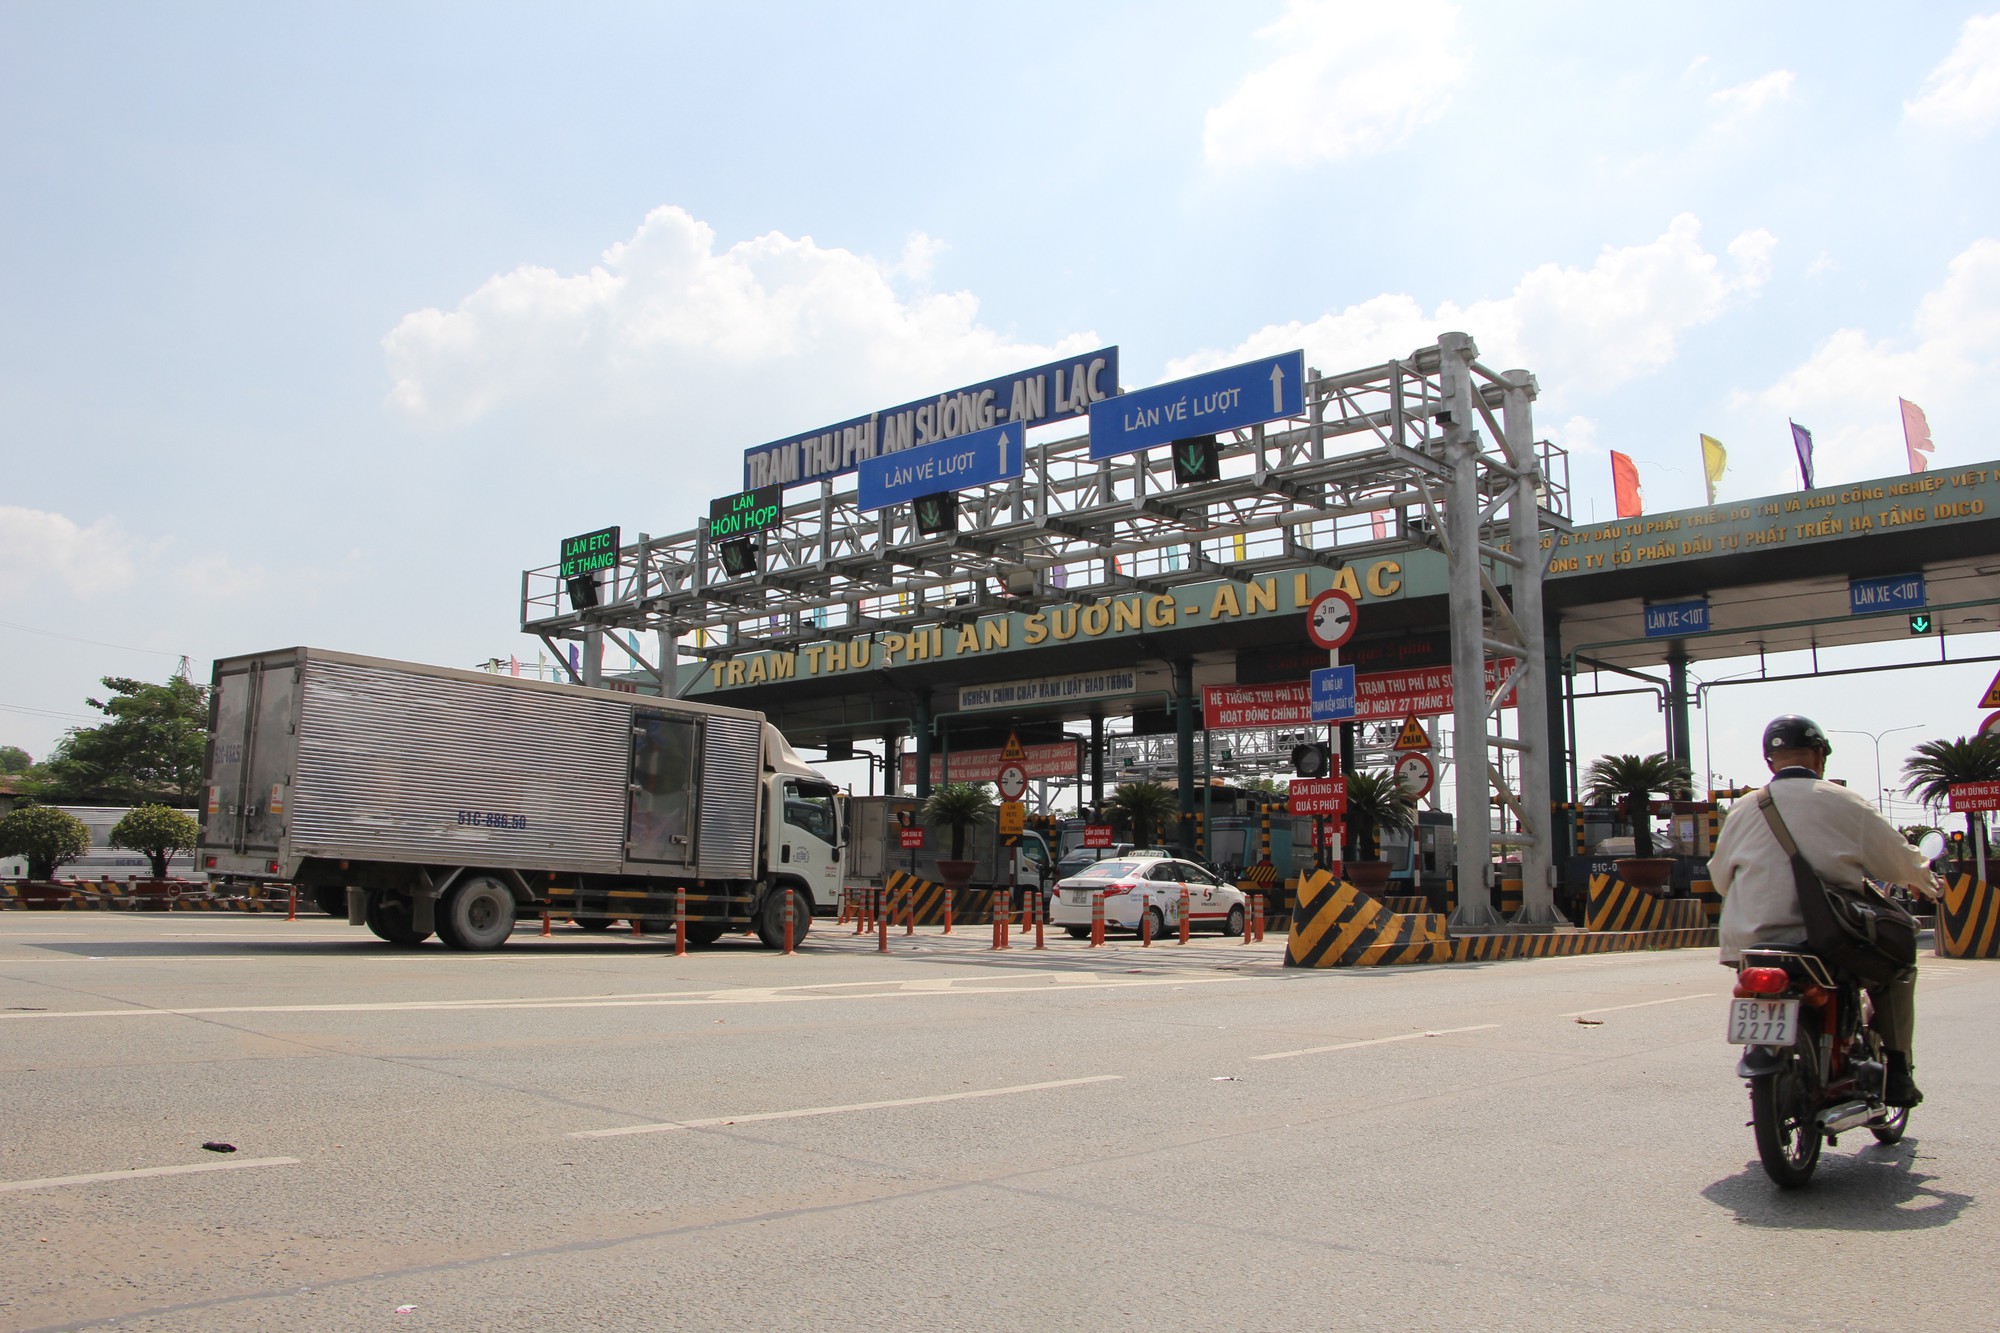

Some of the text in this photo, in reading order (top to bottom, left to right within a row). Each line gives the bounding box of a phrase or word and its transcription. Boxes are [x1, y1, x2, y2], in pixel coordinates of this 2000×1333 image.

[802, 431, 841, 478] THU
[842, 412, 879, 467] PHÍ
[882, 410, 914, 455] AN
[1055, 358, 1106, 414] LẠC
[1123, 388, 1241, 432] LÀN VÉ LƯỢT
[885, 452, 976, 489] LÀN VÉ LƯỢT
[733, 493, 754, 511] LÀN
[1573, 532, 1590, 544] TY
[1625, 522, 1643, 537] TƯ
[1646, 515, 1681, 533] PHÁT
[1731, 505, 1751, 521] ĐÔ
[1755, 502, 1779, 519] THỊ
[1784, 496, 1801, 513] VÀ
[1806, 494, 1836, 510] KHU
[1841, 486, 1884, 504] CÔNG
[1888, 475, 1945, 497] NGHIỆP
[1951, 470, 1987, 490] VIỆT
[710, 505, 777, 538] HỖN HỢP
[1585, 553, 1604, 568] TY
[1612, 542, 1632, 565] CỔ
[1637, 538, 1676, 561] PHẦN
[1681, 534, 1712, 555] ĐẦU
[1718, 532, 1739, 550] TƯ
[1745, 523, 1786, 546] PHÁT
[1794, 512, 1843, 539] TRIỂN
[1849, 515, 1873, 534] HẠ
[1878, 504, 1926, 527] TẦNG
[1934, 499, 1984, 520] IDICO
[566, 533, 610, 556] LÀN ETC
[562, 552, 614, 576] VÉ THÁNG
[1854, 585, 1874, 605] LÀN
[1876, 585, 1890, 602] XE
[805, 639, 871, 674] THU
[884, 623, 943, 661] PHÍ
[955, 619, 1009, 654] AN
[1023, 595, 1176, 645] SƯƠNG
[1209, 577, 1276, 619] AN
[1648, 610, 1665, 629] LÀN
[1668, 611, 1679, 627] XE
[962, 687, 991, 707] NGHIÊM
[1016, 679, 1037, 701] CHẤP
[1062, 674, 1082, 697] LUẬT
[1084, 676, 1104, 693] GIAO
[1106, 670, 1133, 691] THÔNG
[1210, 690, 1223, 707] HỆ
[1225, 688, 1254, 705] THỐNG
[1255, 690, 1274, 703] THU
[1275, 685, 1291, 702] PHÍ
[1358, 680, 1385, 697] TRẠM
[1388, 677, 1406, 692] THU
[1408, 673, 1425, 691] PHÍ
[1427, 676, 1440, 689] AN
[1220, 709, 1243, 725] HOẠT
[1245, 705, 1269, 724] ĐỘNG
[1271, 704, 1298, 720] CHÍNH
[1355, 698, 1370, 715] GIỜ
[1372, 696, 1398, 714] NGÀY
[1399, 698, 1410, 712] 27
[1412, 692, 1443, 711] THÁNG
[1292, 781, 1343, 795] CẤM DỪNG XE
[1951, 785, 2000, 796] CẤM DỪNG XE
[1296, 797, 1339, 811] QUÁ 5 PHÚT
[1955, 797, 1997, 809] QUÁ 5 PHÚT
[1738, 1022, 1785, 1040] 2272
